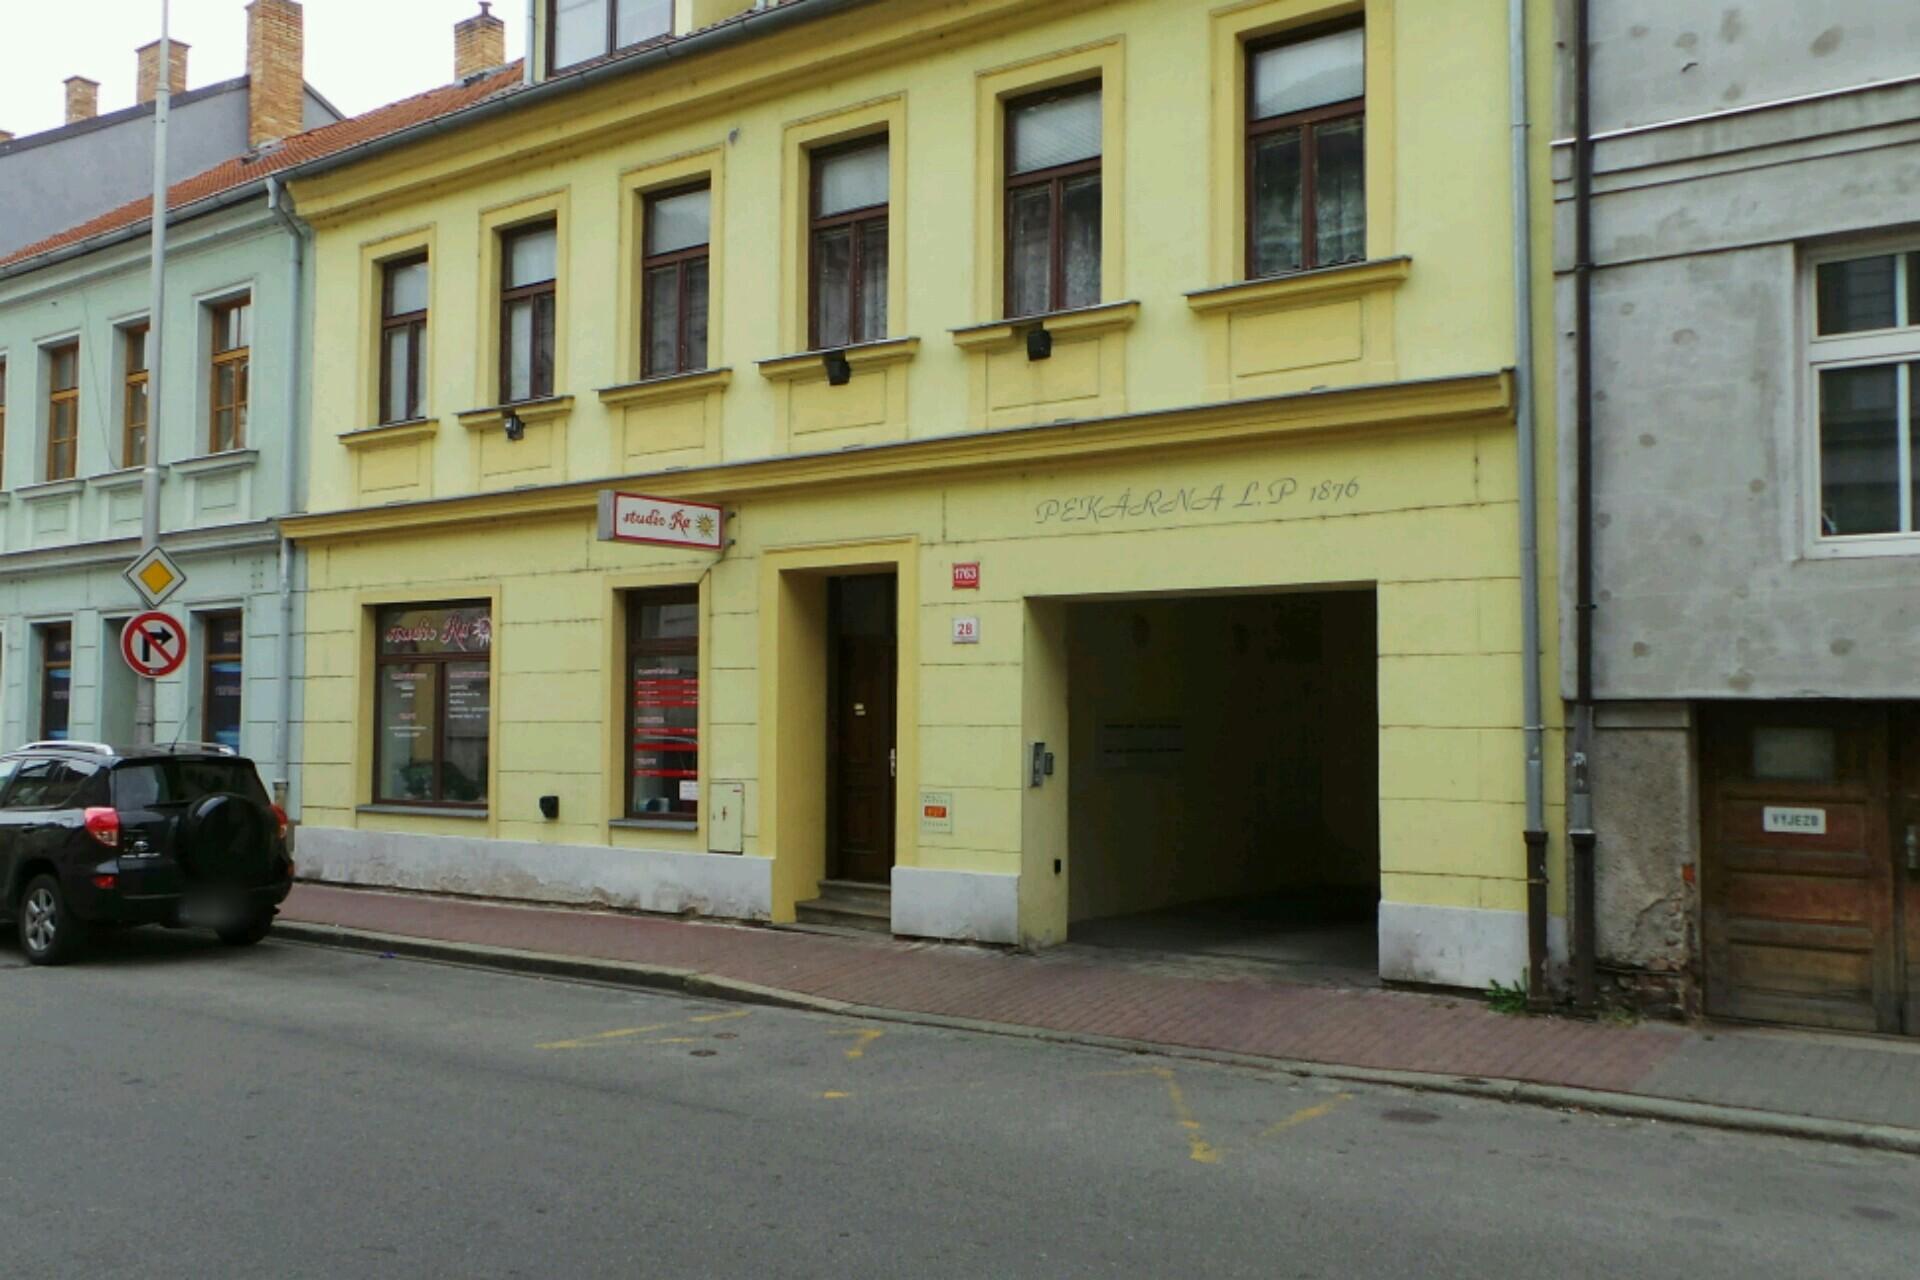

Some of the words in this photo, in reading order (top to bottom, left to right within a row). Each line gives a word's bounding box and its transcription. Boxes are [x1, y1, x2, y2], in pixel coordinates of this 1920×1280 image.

[1036, 484, 1224, 523] PEKÁRNA
[1309, 476, 1360, 503] 1876
[623, 508, 666, 527] studio
[957, 623, 973, 635] 28
